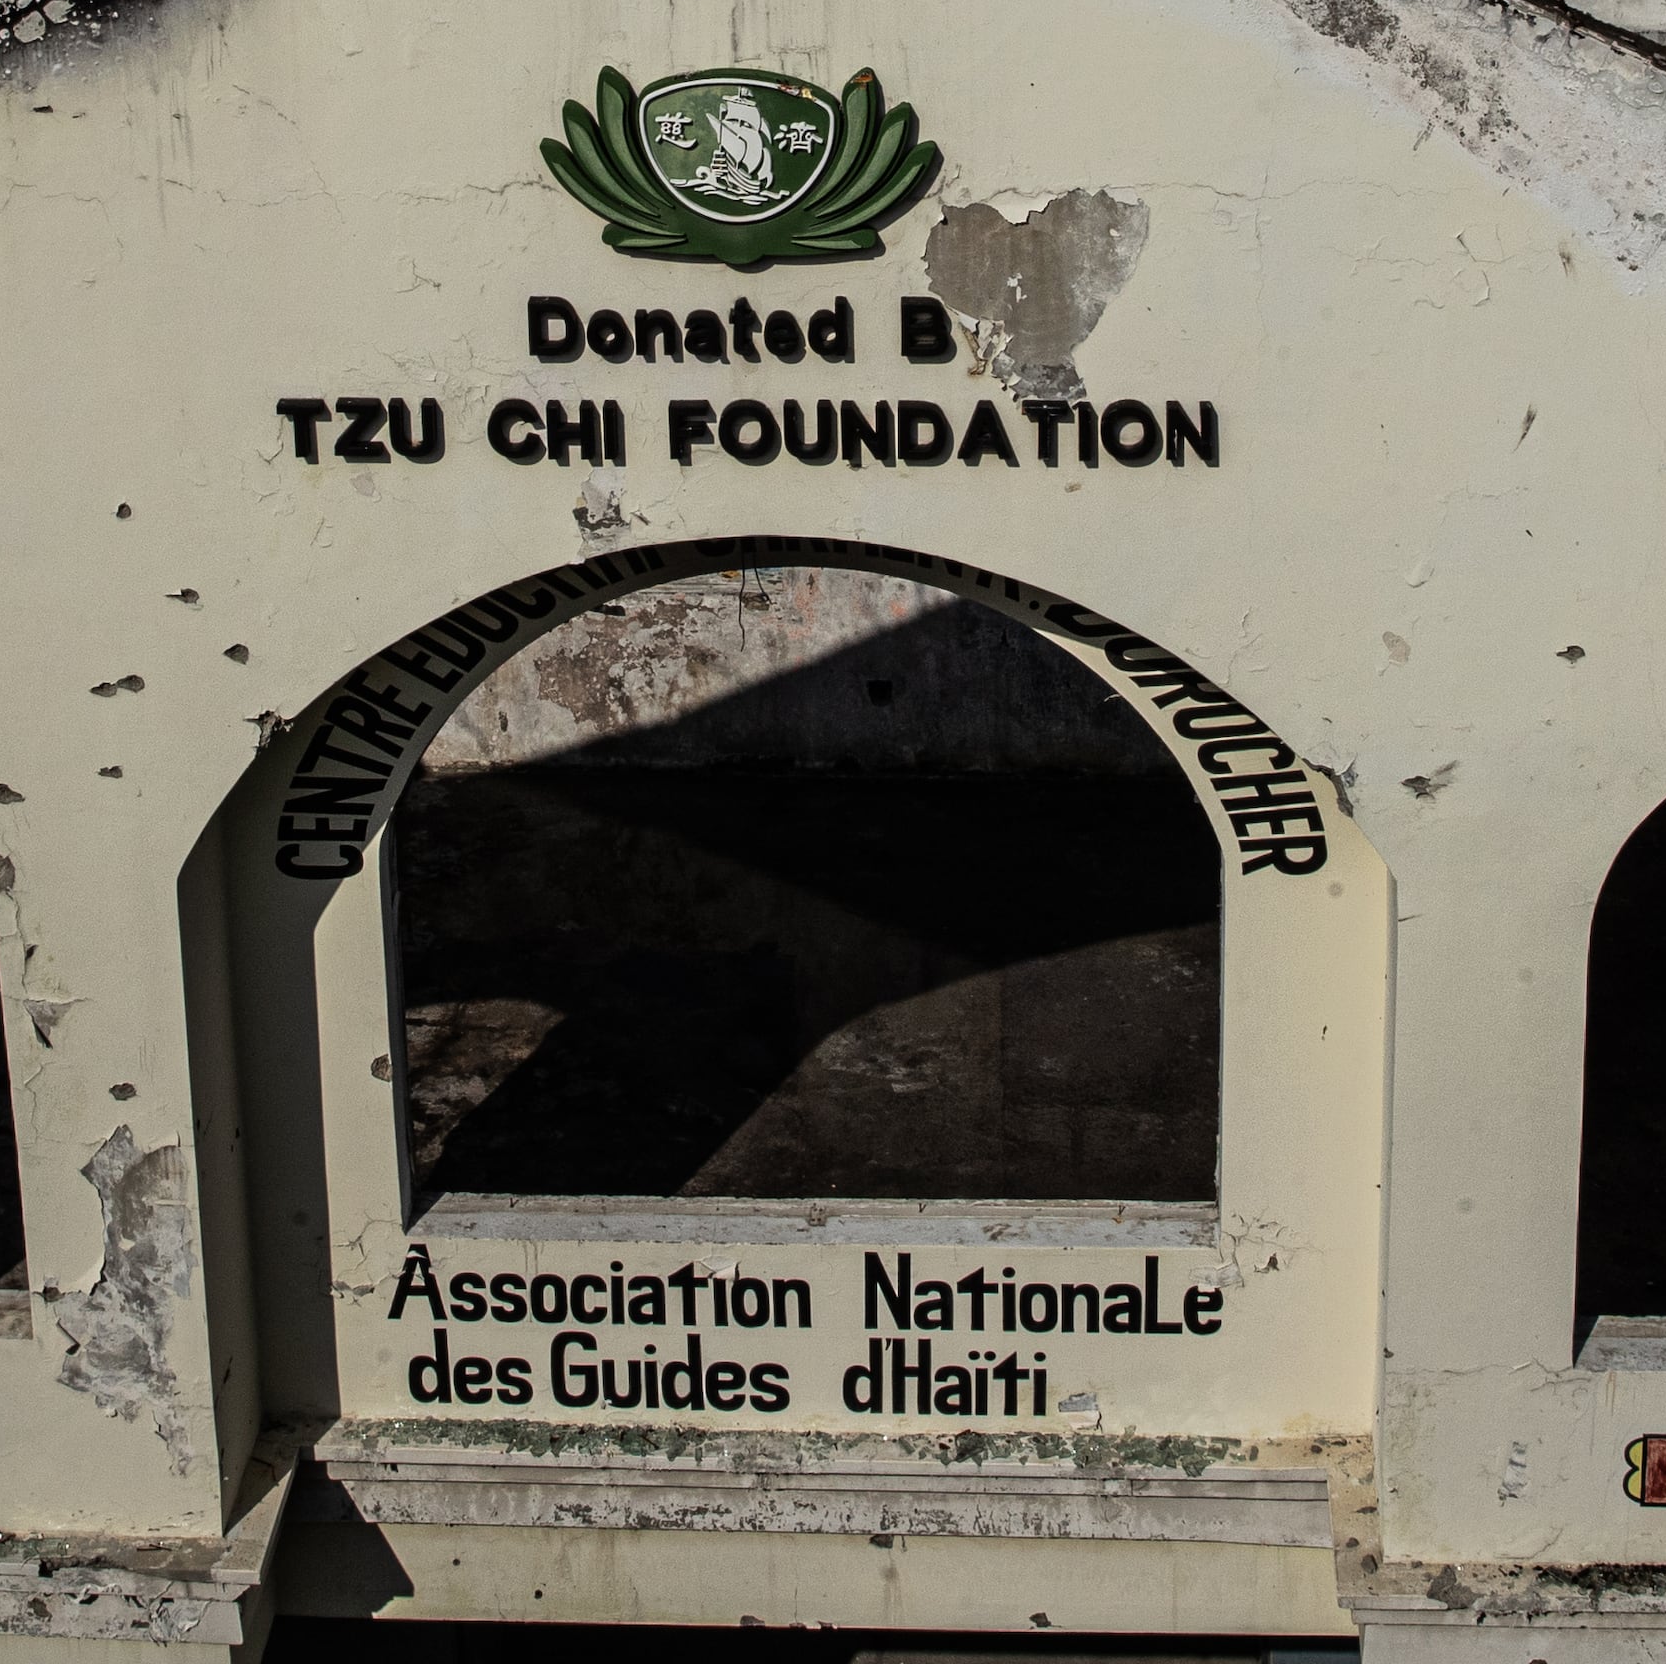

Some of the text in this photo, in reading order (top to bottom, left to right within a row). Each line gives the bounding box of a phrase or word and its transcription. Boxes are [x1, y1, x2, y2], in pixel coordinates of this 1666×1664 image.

[528, 295, 855, 363] Donated
[277, 398, 1220, 469] TZU CHI FOUNDATION
[275, 668, 433, 880] CENTRE
[378, 545, 665, 694] EDUC
[388, 1243, 812, 1328] Association
[408, 1328, 1047, 1417] des Guides d'Haïti
